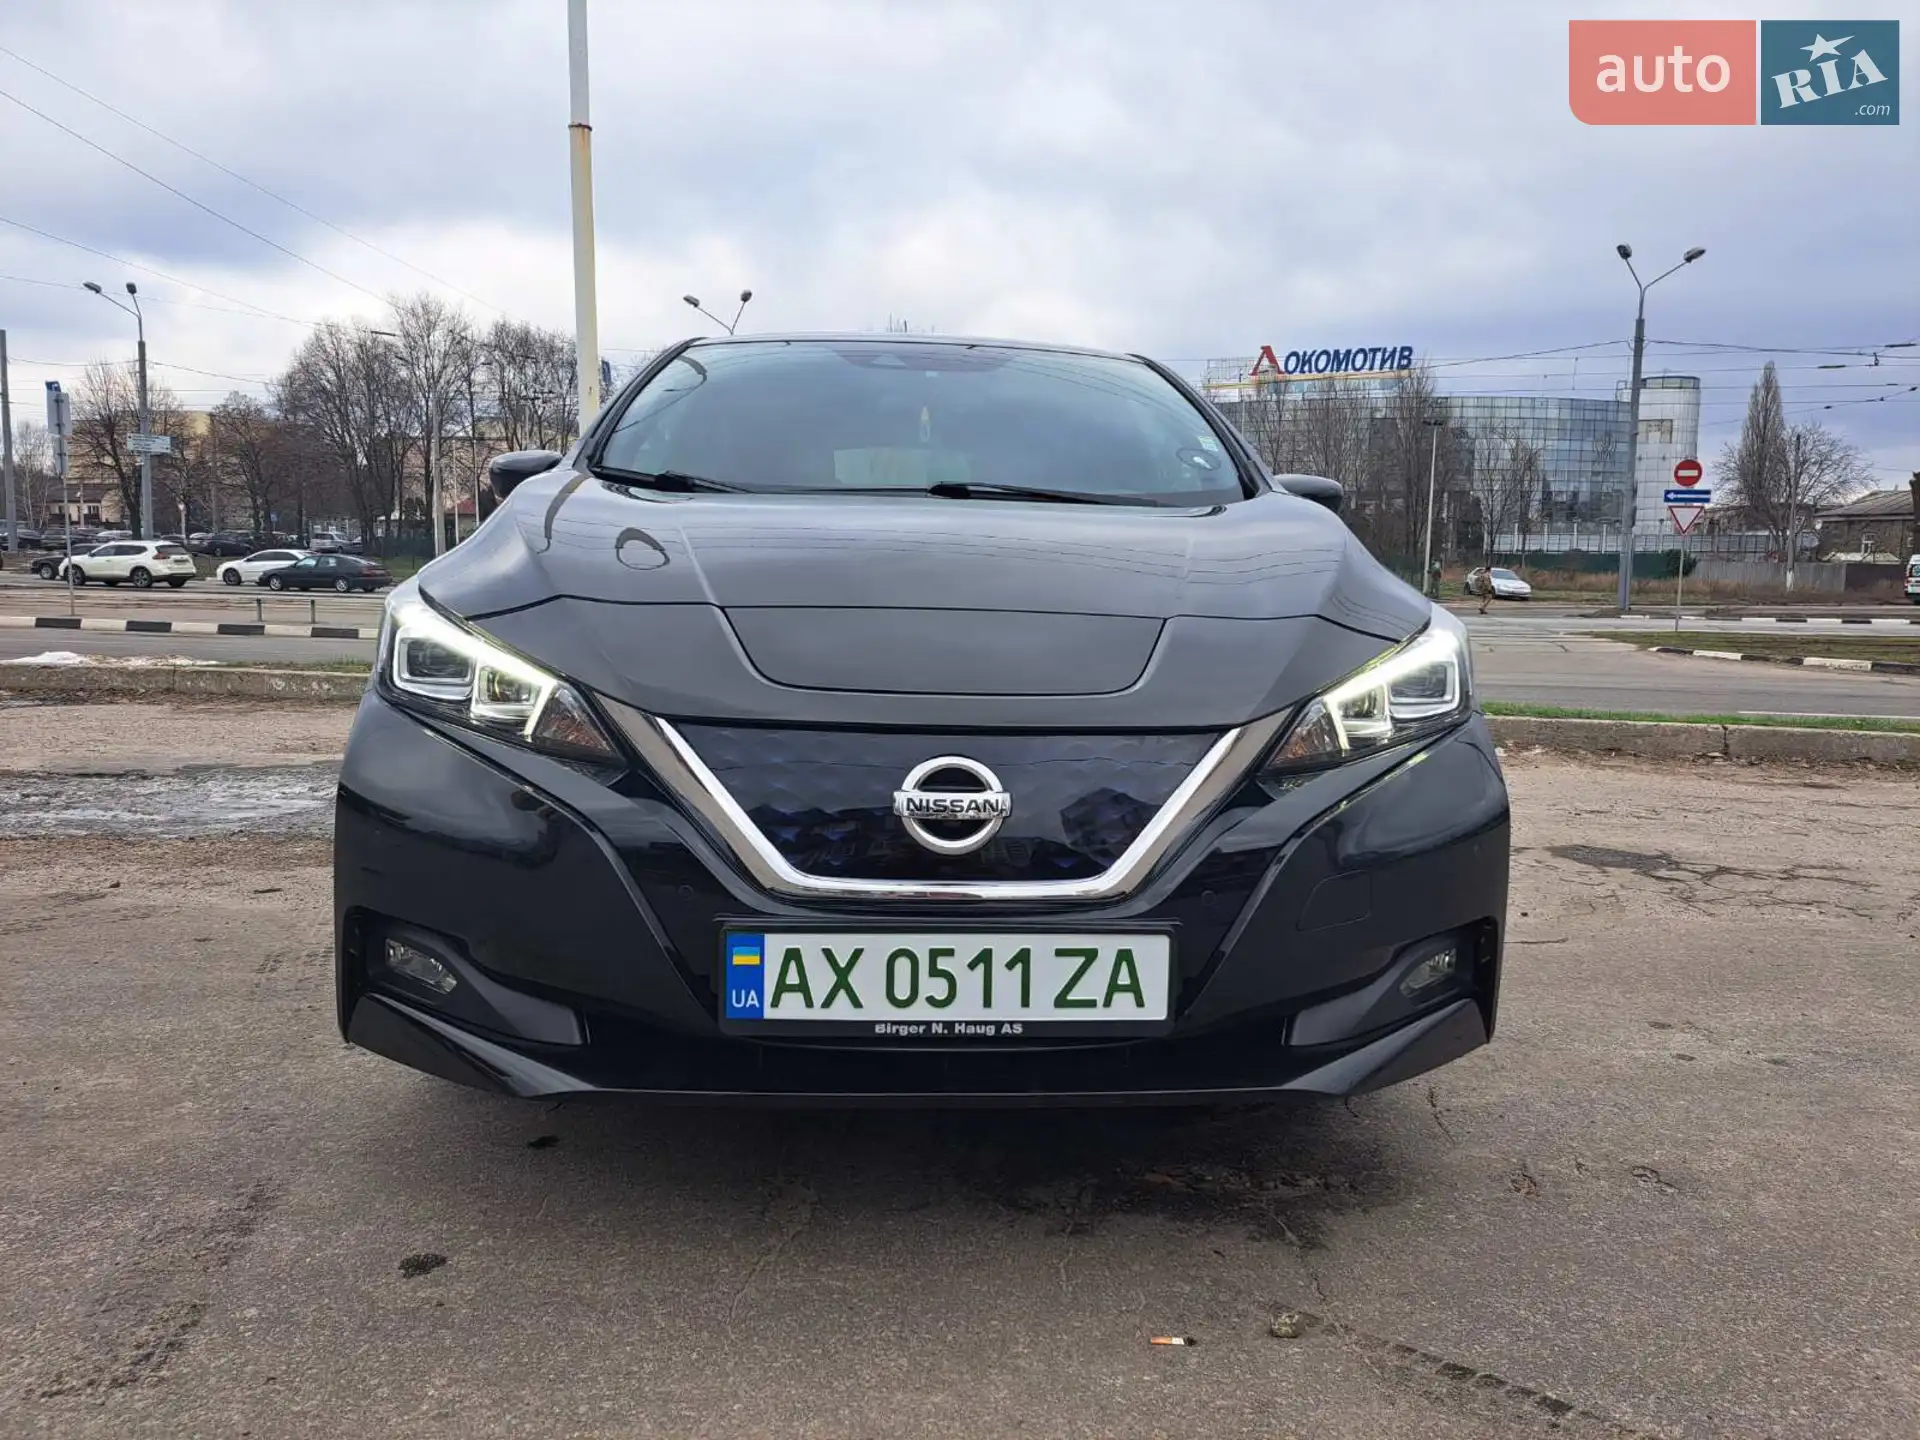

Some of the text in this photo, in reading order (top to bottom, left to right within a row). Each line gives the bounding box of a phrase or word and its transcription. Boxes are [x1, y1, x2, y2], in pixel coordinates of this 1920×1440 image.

[1249, 345, 1413, 376] ЛОКОМОТИВ
[905, 798, 1000, 813] NISSAN
[769, 946, 1146, 1009] AX 0511 ZA
[731, 989, 760, 1008] UA
[874, 1022, 1024, 1036] Birger N. Haug AS
